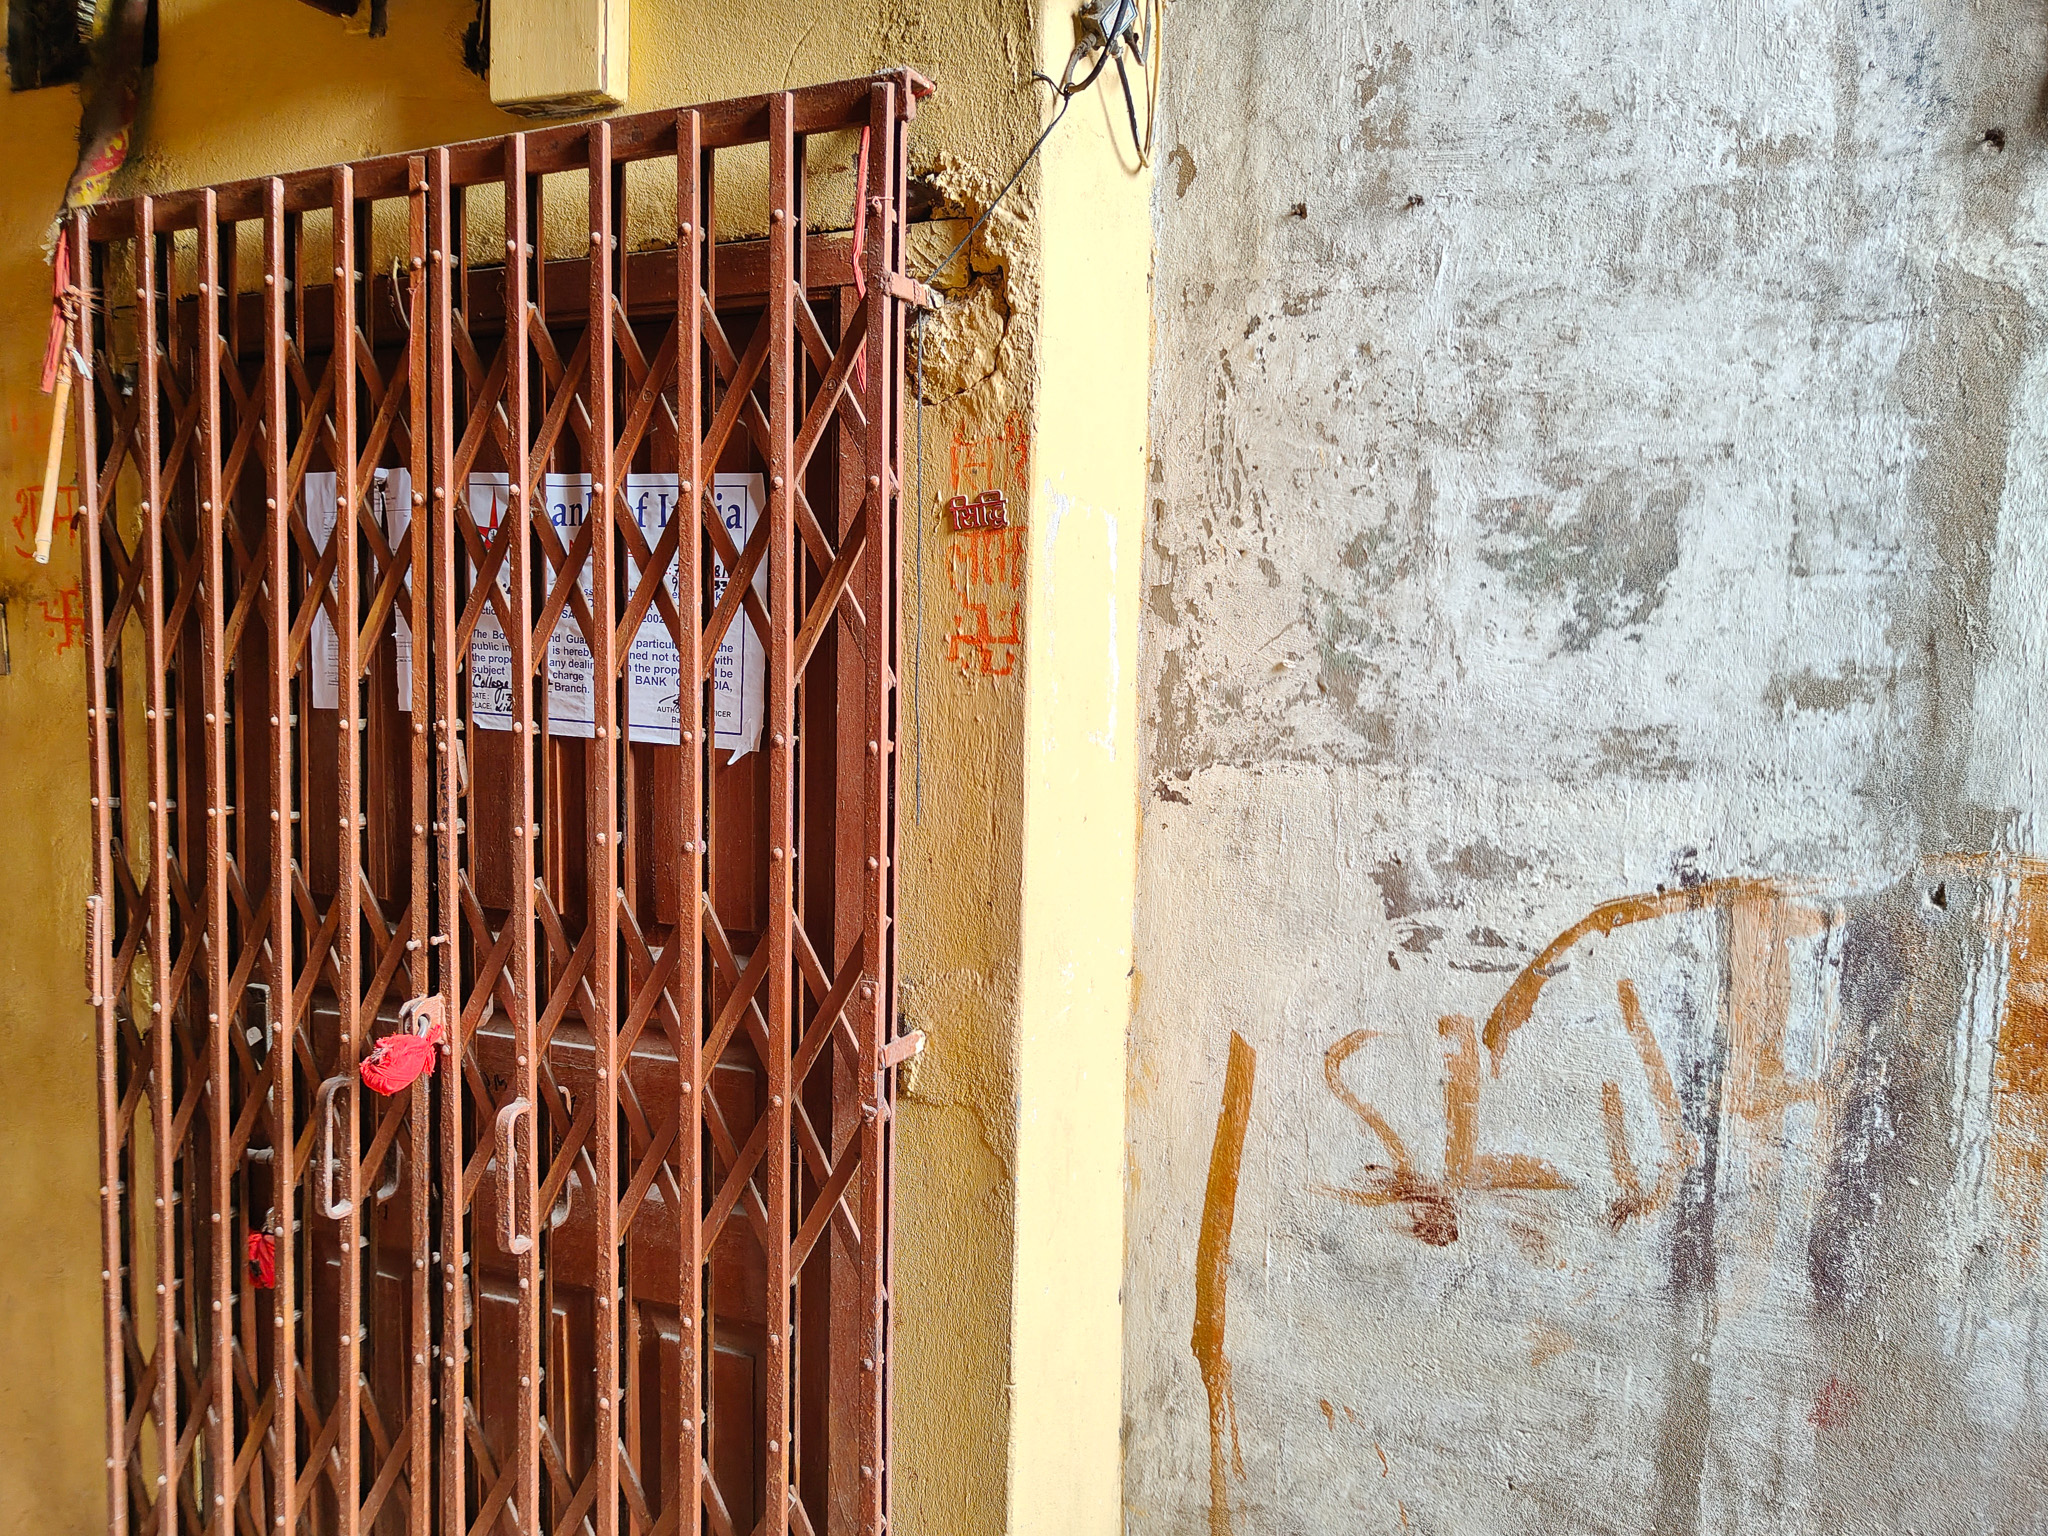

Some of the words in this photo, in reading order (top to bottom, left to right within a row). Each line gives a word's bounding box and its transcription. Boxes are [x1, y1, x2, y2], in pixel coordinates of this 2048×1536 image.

[546, 492, 592, 527] an
[630, 492, 649, 528] f
[658, 493, 742, 530] Iia
[950, 489, 1010, 531] सिद्धि
[473, 629, 487, 639] The
[636, 640, 676, 650] particul
[472, 642, 500, 652] public
[552, 646, 560, 655] is
[651, 653, 669, 662] not
[472, 653, 486, 662] the
[549, 660, 566, 669] any
[635, 663, 651, 673] the
[720, 668, 733, 678] be
[472, 666, 505, 676] subject
[552, 671, 584, 683] charge
[635, 675, 667, 687] BANK
[554, 682, 590, 694] Branch.
[715, 710, 731, 718] ICER
